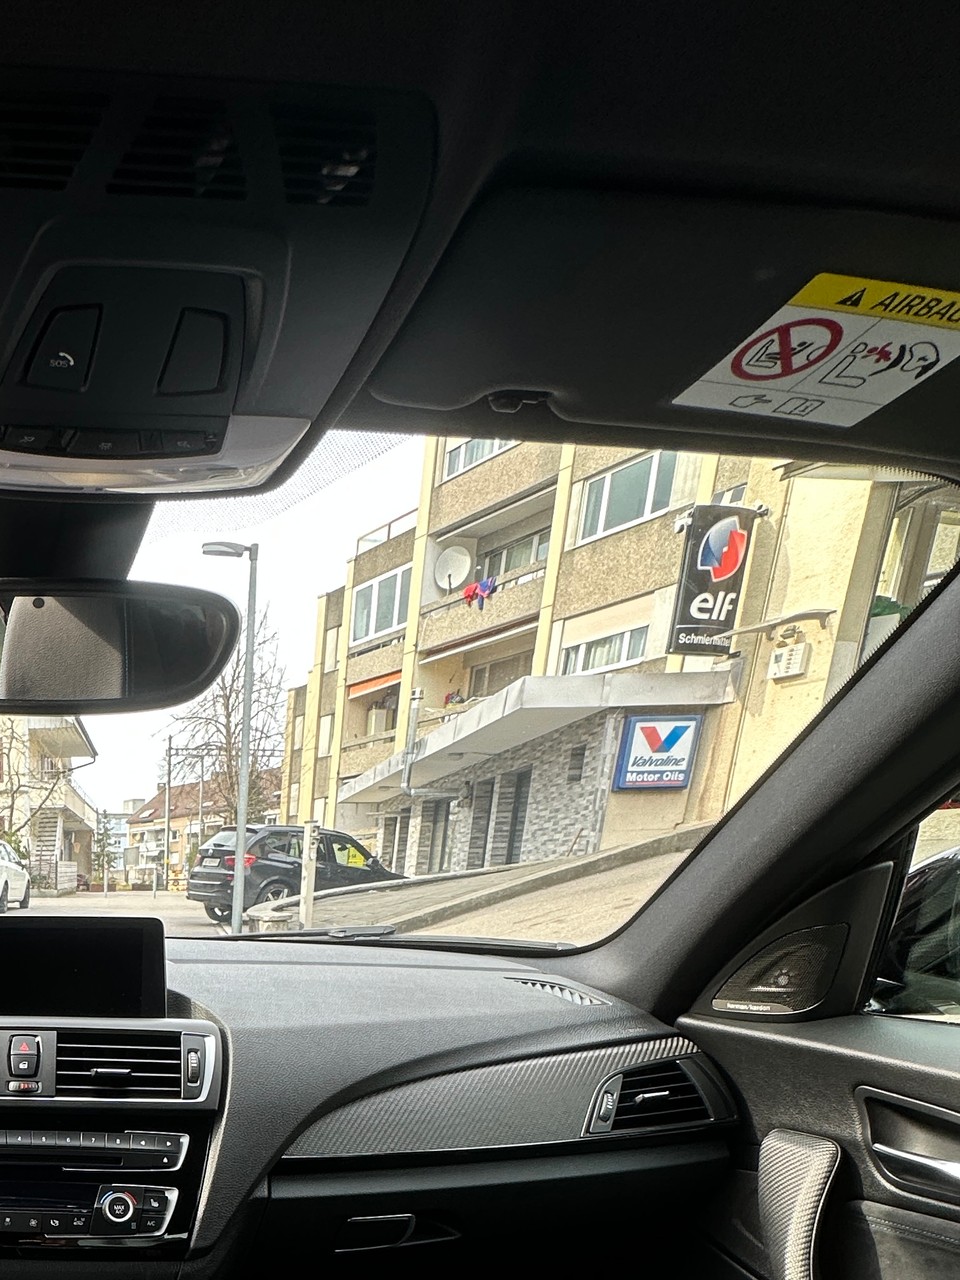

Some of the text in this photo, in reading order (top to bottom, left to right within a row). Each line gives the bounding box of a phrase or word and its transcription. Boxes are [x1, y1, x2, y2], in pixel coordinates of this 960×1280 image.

[49, 359, 68, 368] SOS
[689, 591, 737, 621] elf
[631, 755, 686, 768] Valvoline
[625, 771, 685, 782] Motor Oils
